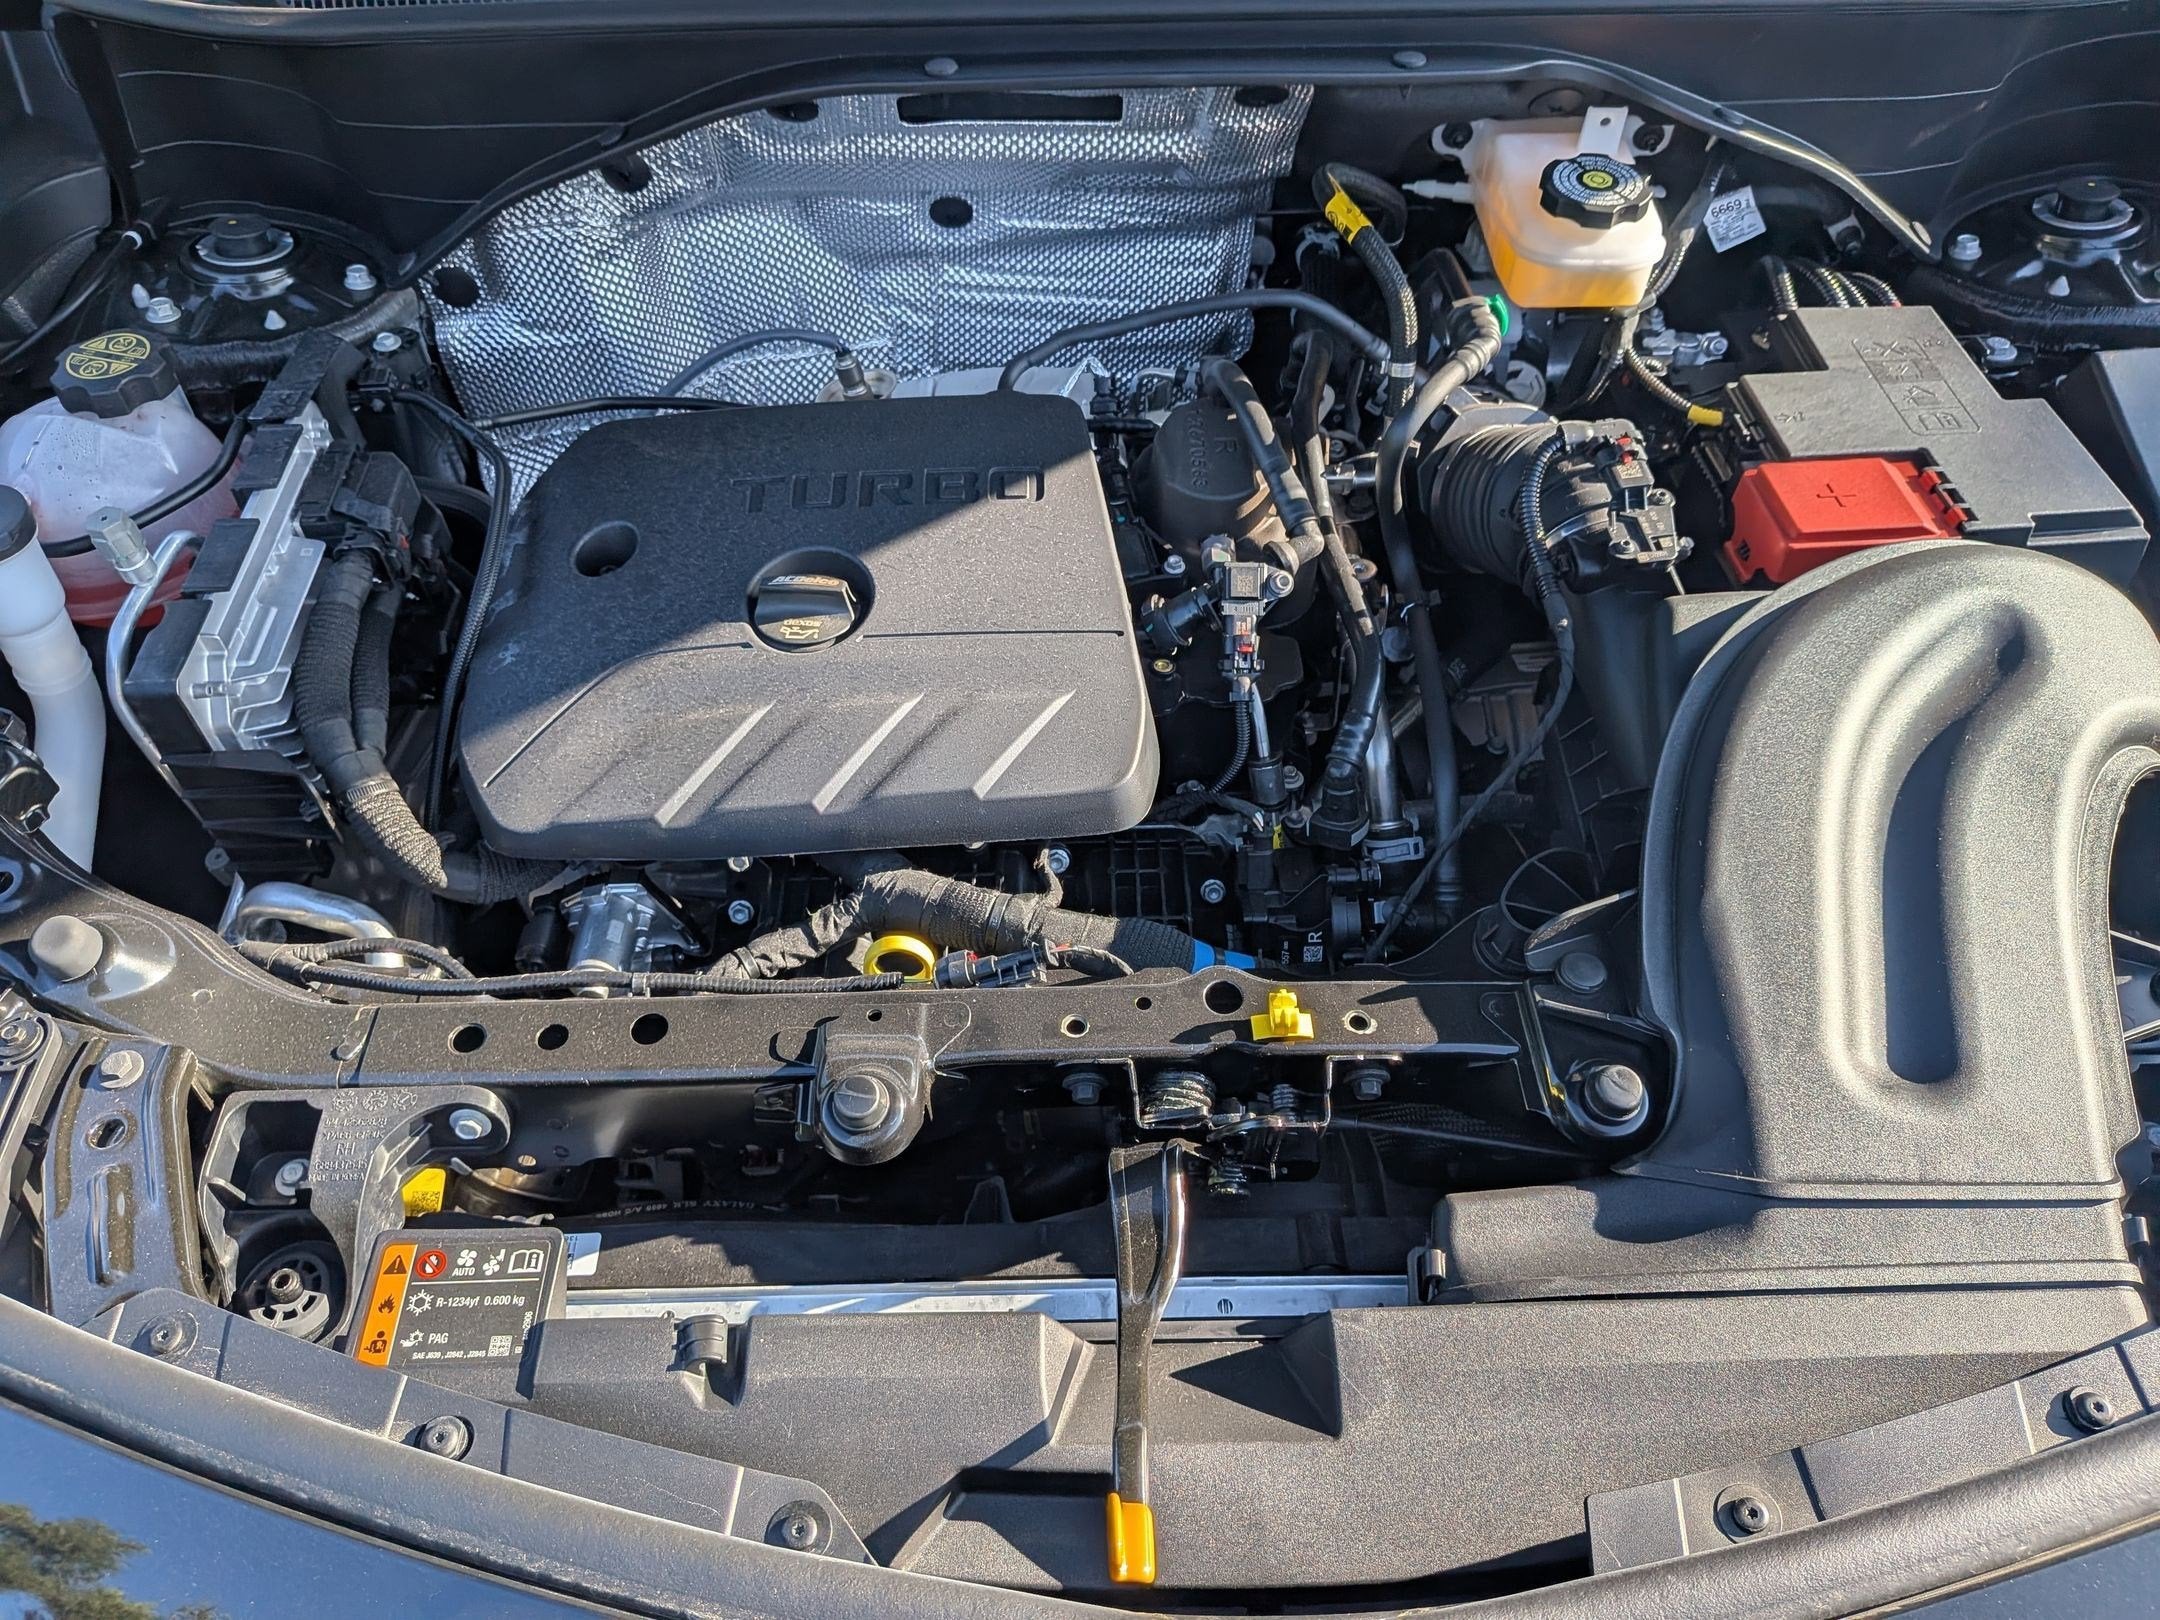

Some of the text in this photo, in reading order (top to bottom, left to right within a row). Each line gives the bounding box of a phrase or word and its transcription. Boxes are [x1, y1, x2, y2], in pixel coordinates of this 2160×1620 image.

[1711, 199, 1742, 218] 6669
[730, 466, 1045, 513] TURBO
[1308, 931, 1323, 943] R
[336, 1142, 356, 1156] RH
[452, 1267, 476, 1276] AUTO
[436, 1295, 525, 1308] R-1234yf 0.600 kg
[428, 1333, 449, 1344] PAG
[412, 1352, 425, 1360] SAE
